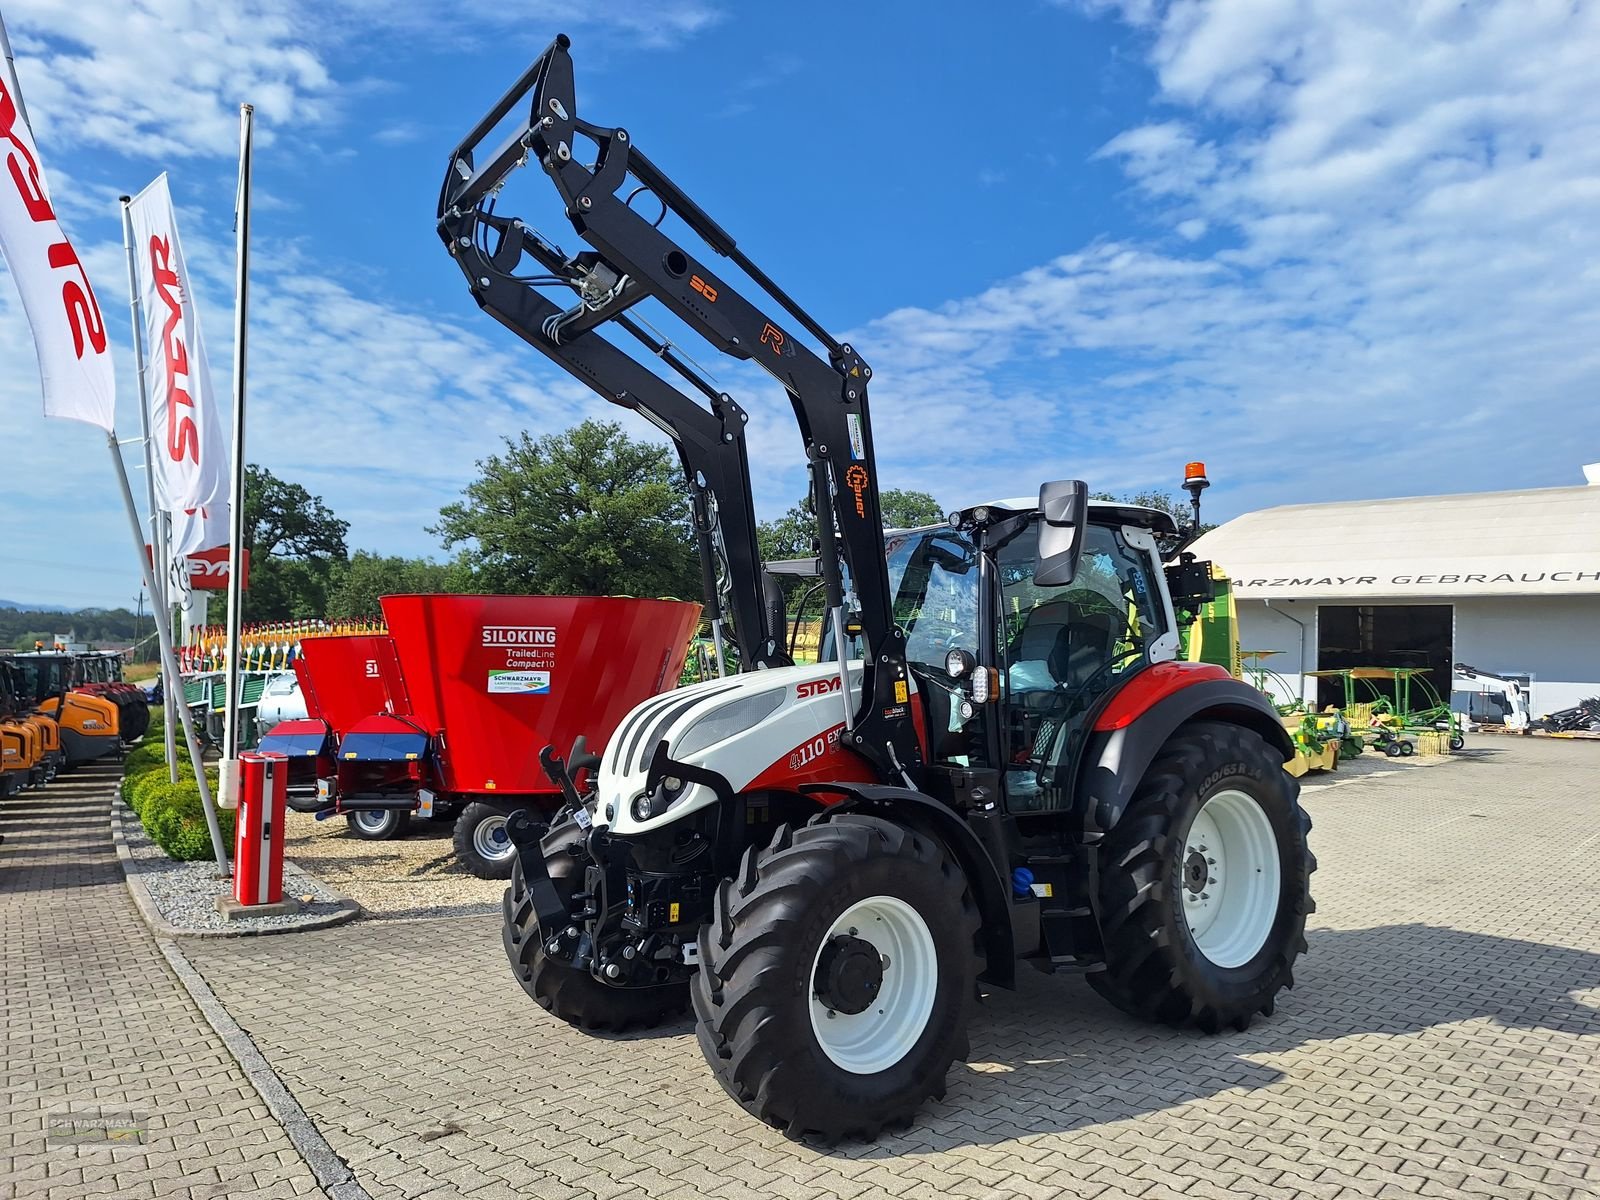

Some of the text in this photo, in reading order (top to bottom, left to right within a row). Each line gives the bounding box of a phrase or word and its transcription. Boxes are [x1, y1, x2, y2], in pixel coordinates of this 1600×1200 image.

[150, 232, 199, 466] STEYR
[187, 559, 230, 577] EYR
[1231, 576, 1377, 587] ARZMAYR
[482, 630, 556, 643] SILOKING
[506, 648, 555, 658] TrailedLine
[506, 659, 545, 669] Compact
[789, 737, 825, 771] 4110
